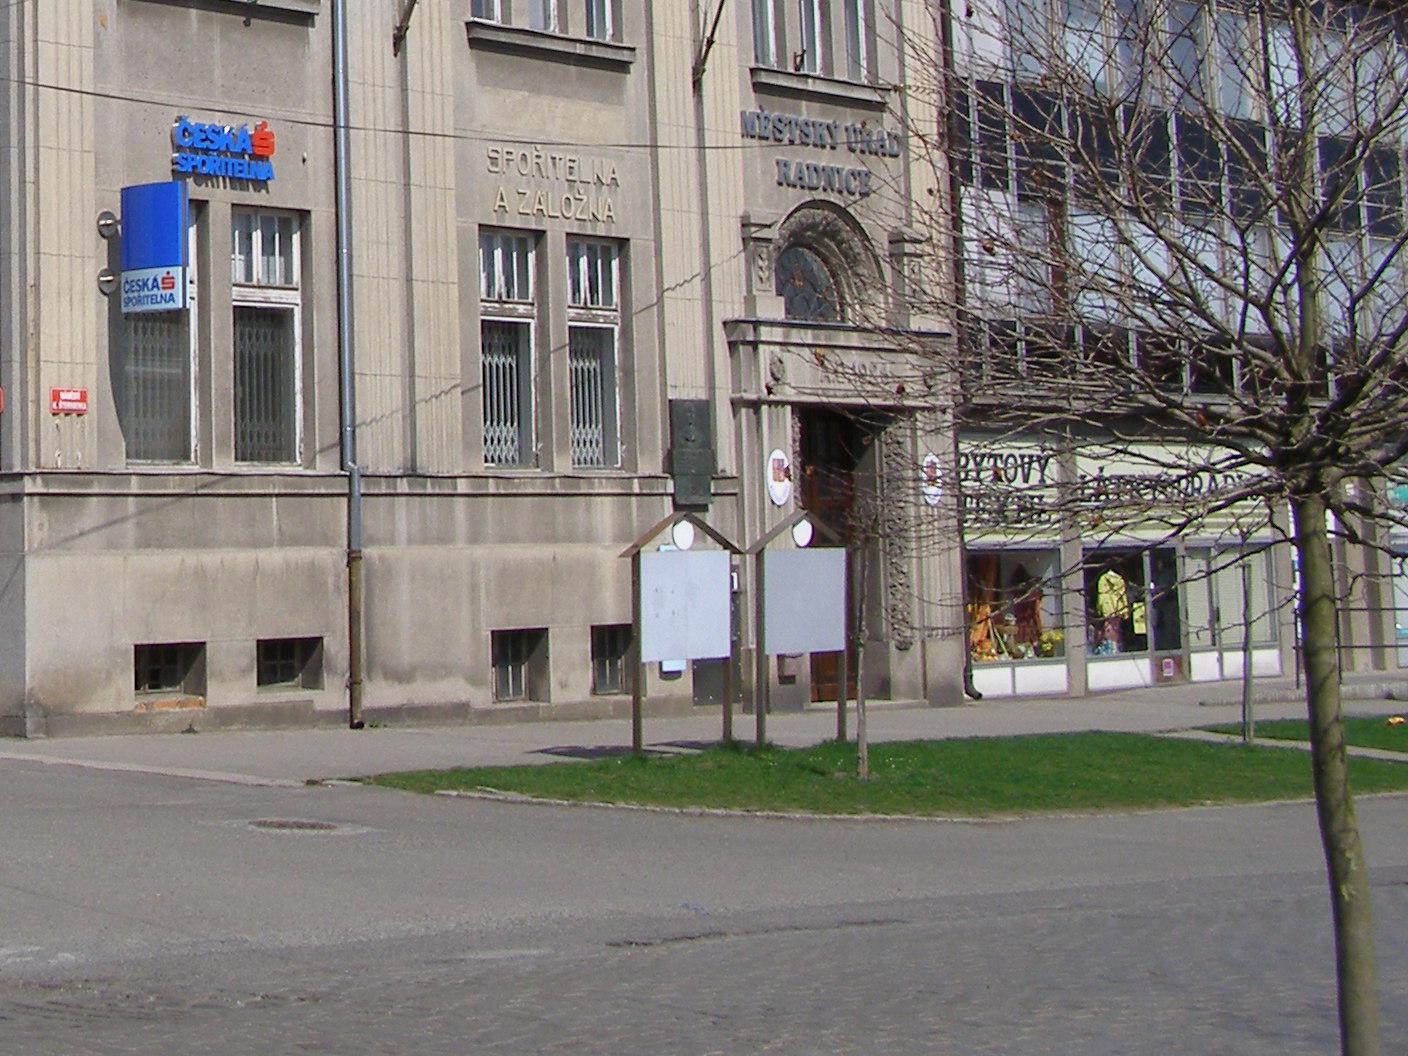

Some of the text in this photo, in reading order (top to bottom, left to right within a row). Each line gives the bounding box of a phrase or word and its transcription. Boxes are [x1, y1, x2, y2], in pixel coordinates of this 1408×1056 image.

[174, 115, 252, 154] ČESKÁ
[173, 152, 275, 181] SPOŘITELNA
[487, 146, 620, 188] SPOŘITELNA
[776, 158, 871, 198] RADNICE
[494, 187, 509, 214] A
[123, 275, 160, 293] ČESKÁ
[123, 292, 176, 308] SPOŘITELNA
